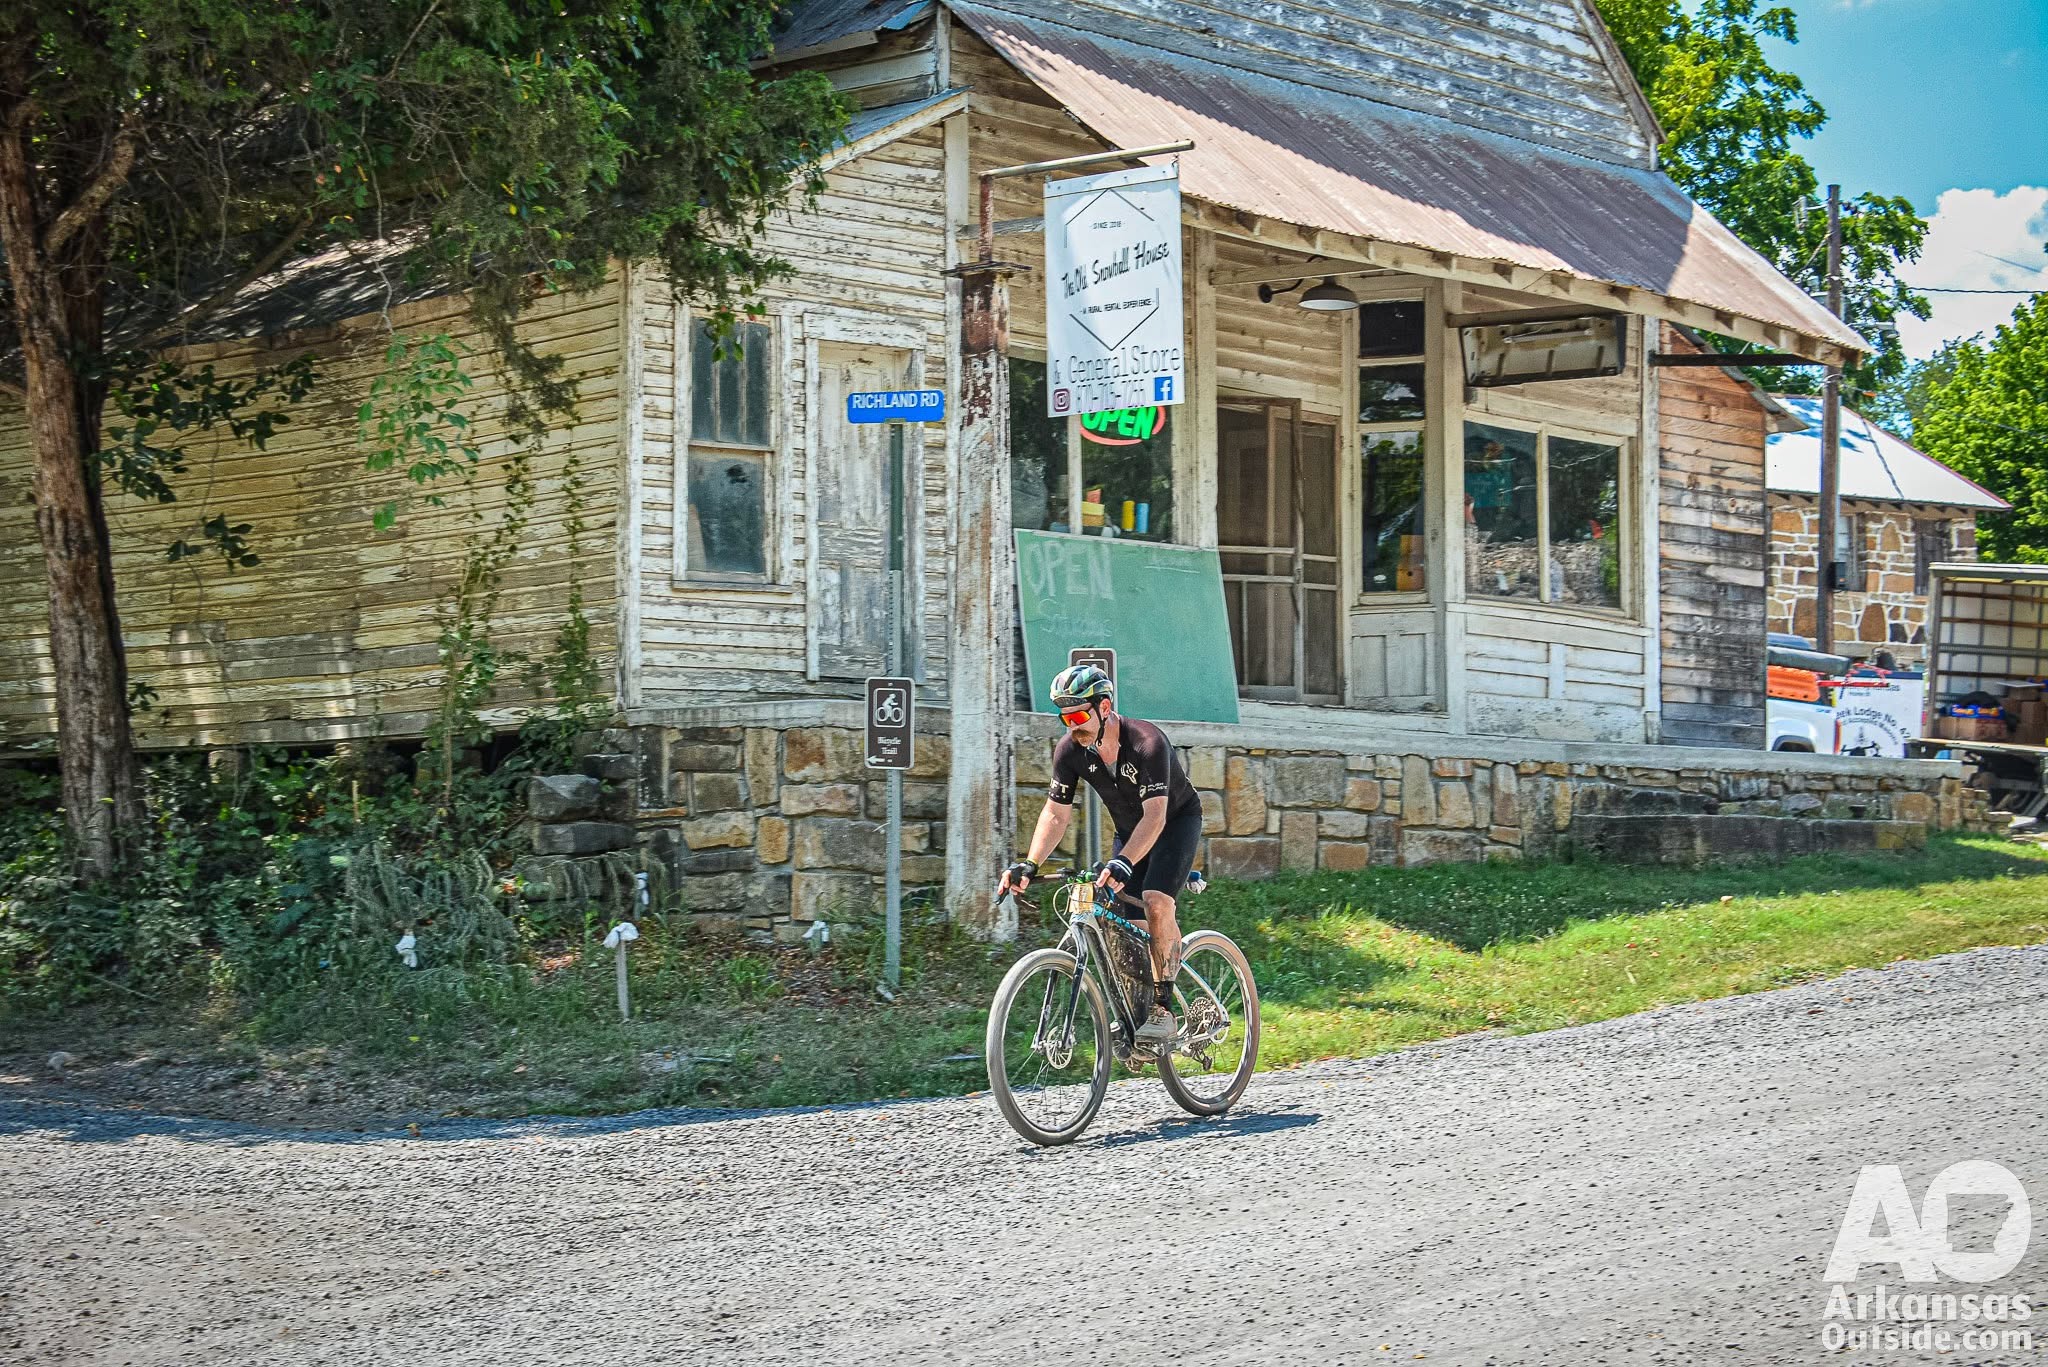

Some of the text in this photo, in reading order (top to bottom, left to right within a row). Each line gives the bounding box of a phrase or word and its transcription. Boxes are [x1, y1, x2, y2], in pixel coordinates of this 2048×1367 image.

[1092, 246, 1130, 285] Snowball
[1133, 240, 1170, 270] House
[1068, 347, 1129, 384] General
[1131, 345, 1180, 375] Store
[852, 392, 939, 409] RICHLAND RD
[1082, 406, 1157, 440] OPEN
[1024, 541, 1115, 600] OPEN
[1854, 706, 1883, 720] Lodge
